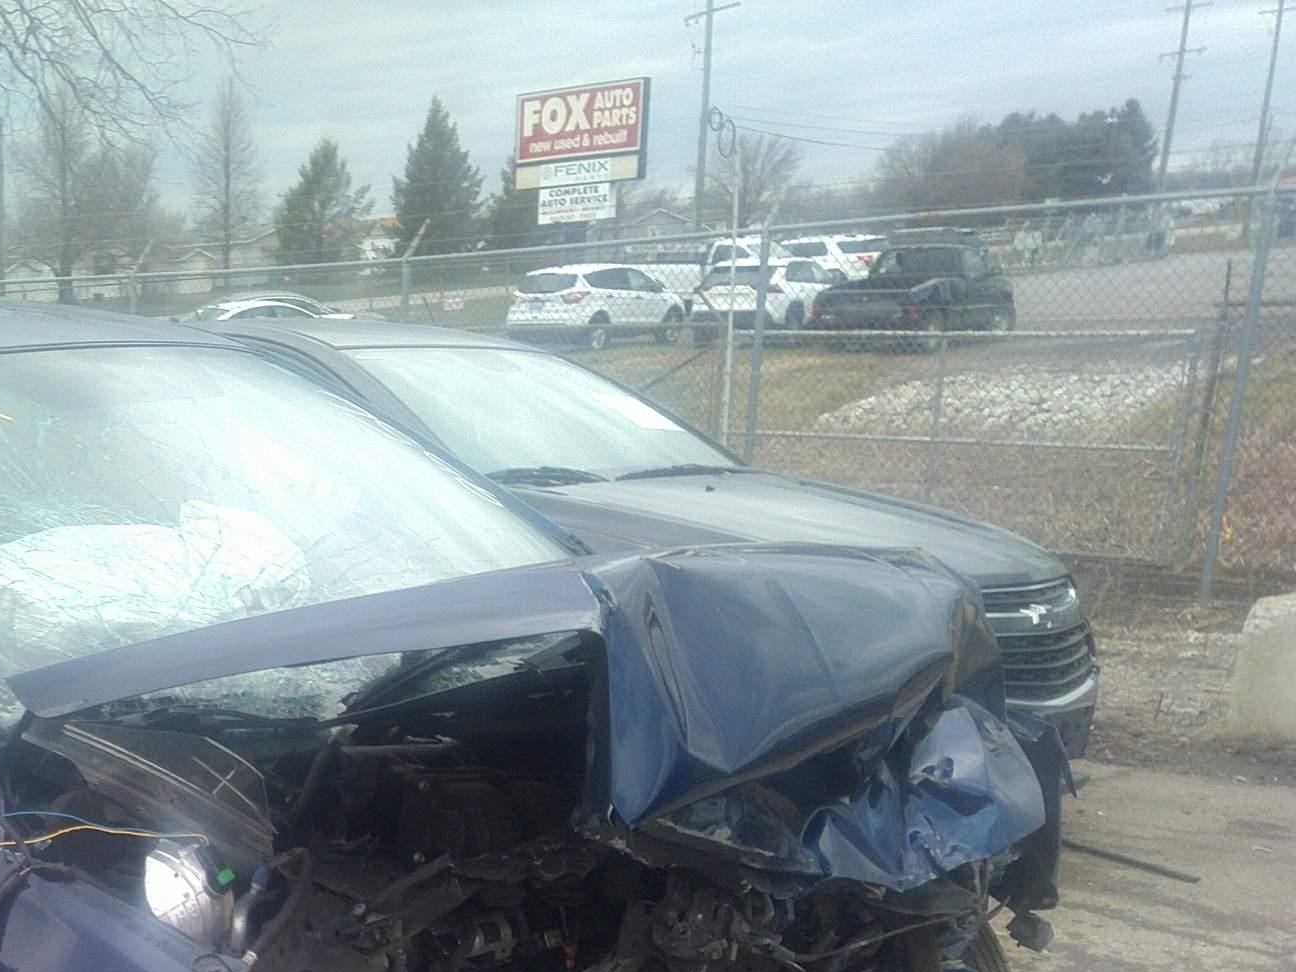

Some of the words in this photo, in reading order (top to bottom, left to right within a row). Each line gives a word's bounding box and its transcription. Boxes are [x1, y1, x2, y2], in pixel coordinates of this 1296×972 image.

[594, 88, 633, 109] AUTO
[523, 93, 591, 137] FOX
[592, 108, 637, 128] PARTS
[529, 140, 552, 153] new
[554, 135, 580, 151] used
[581, 133, 591, 147] &
[593, 129, 627, 146] rebuilt
[554, 160, 609, 177] FENIX
[540, 197, 567, 208] AUTO
[569, 194, 608, 205] SERVICE
[548, 185, 600, 198] COMPLETE
